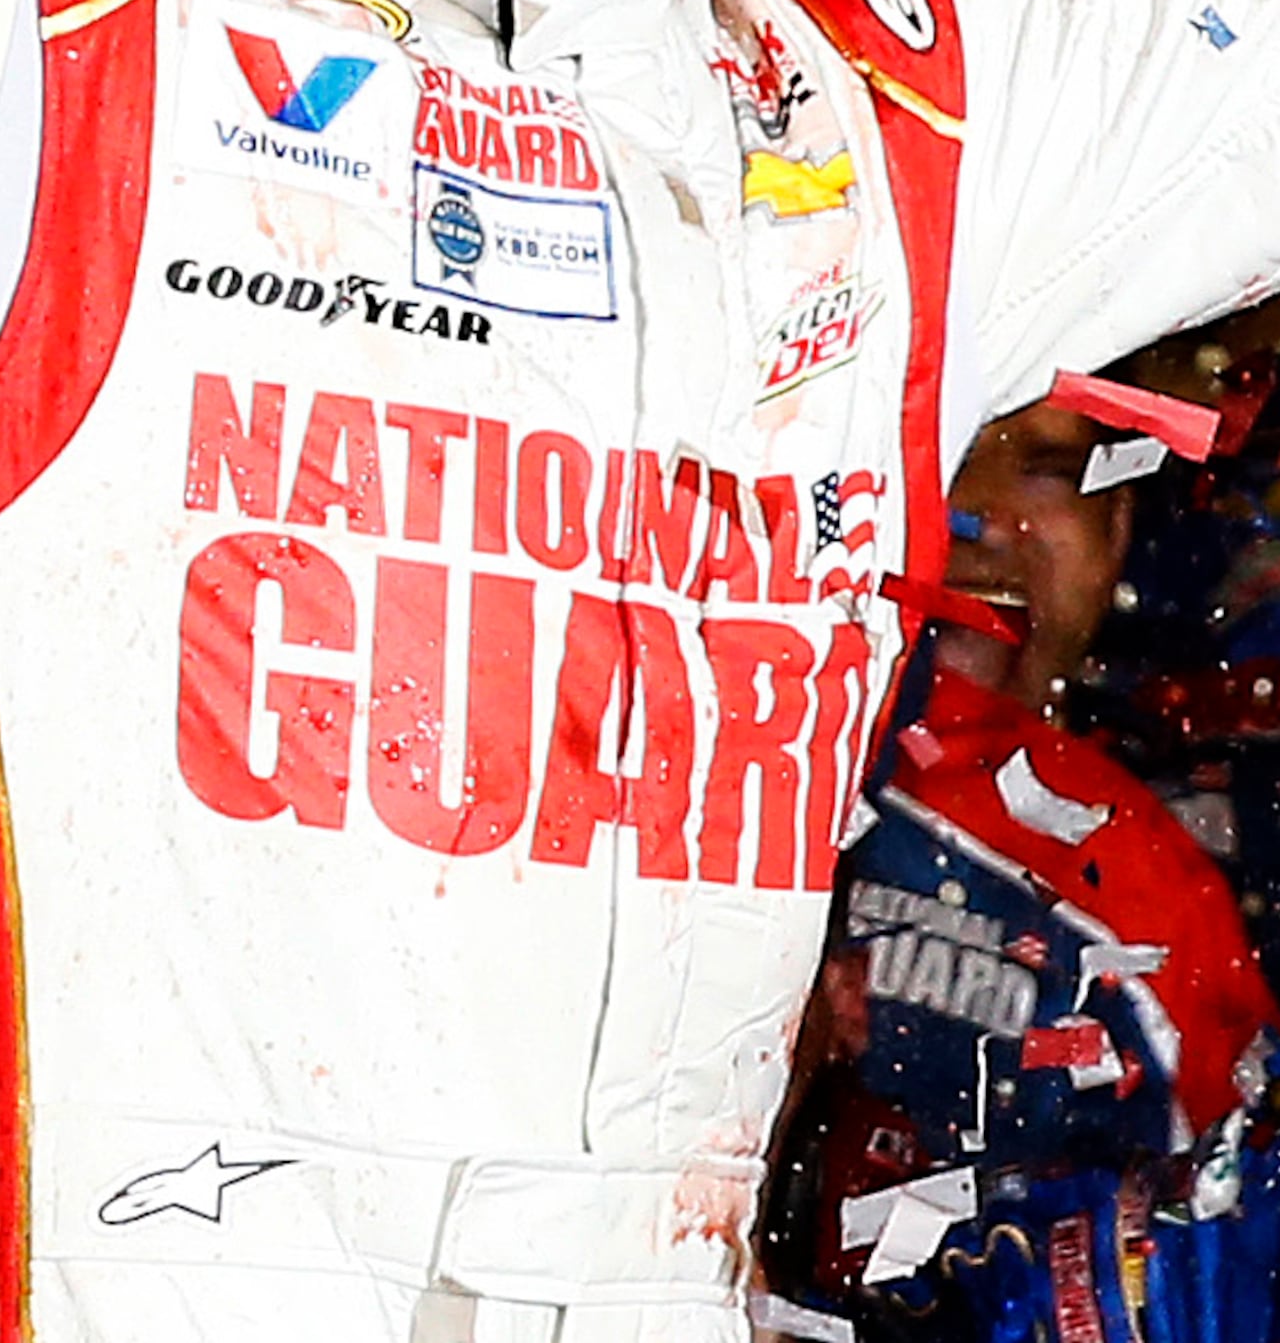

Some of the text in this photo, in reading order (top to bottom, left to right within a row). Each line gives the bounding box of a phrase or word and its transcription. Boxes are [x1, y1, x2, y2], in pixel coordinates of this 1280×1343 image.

[214, 119, 372, 182] Valvoline
[413, 97, 600, 192] GUARD
[495, 234, 600, 265] KBB.COM
[165, 258, 493, 346] GOODYEAR
[183, 372, 810, 605] NATIONAL
[176, 531, 870, 892] GUARD
[848, 914, 1038, 1040] UARD
